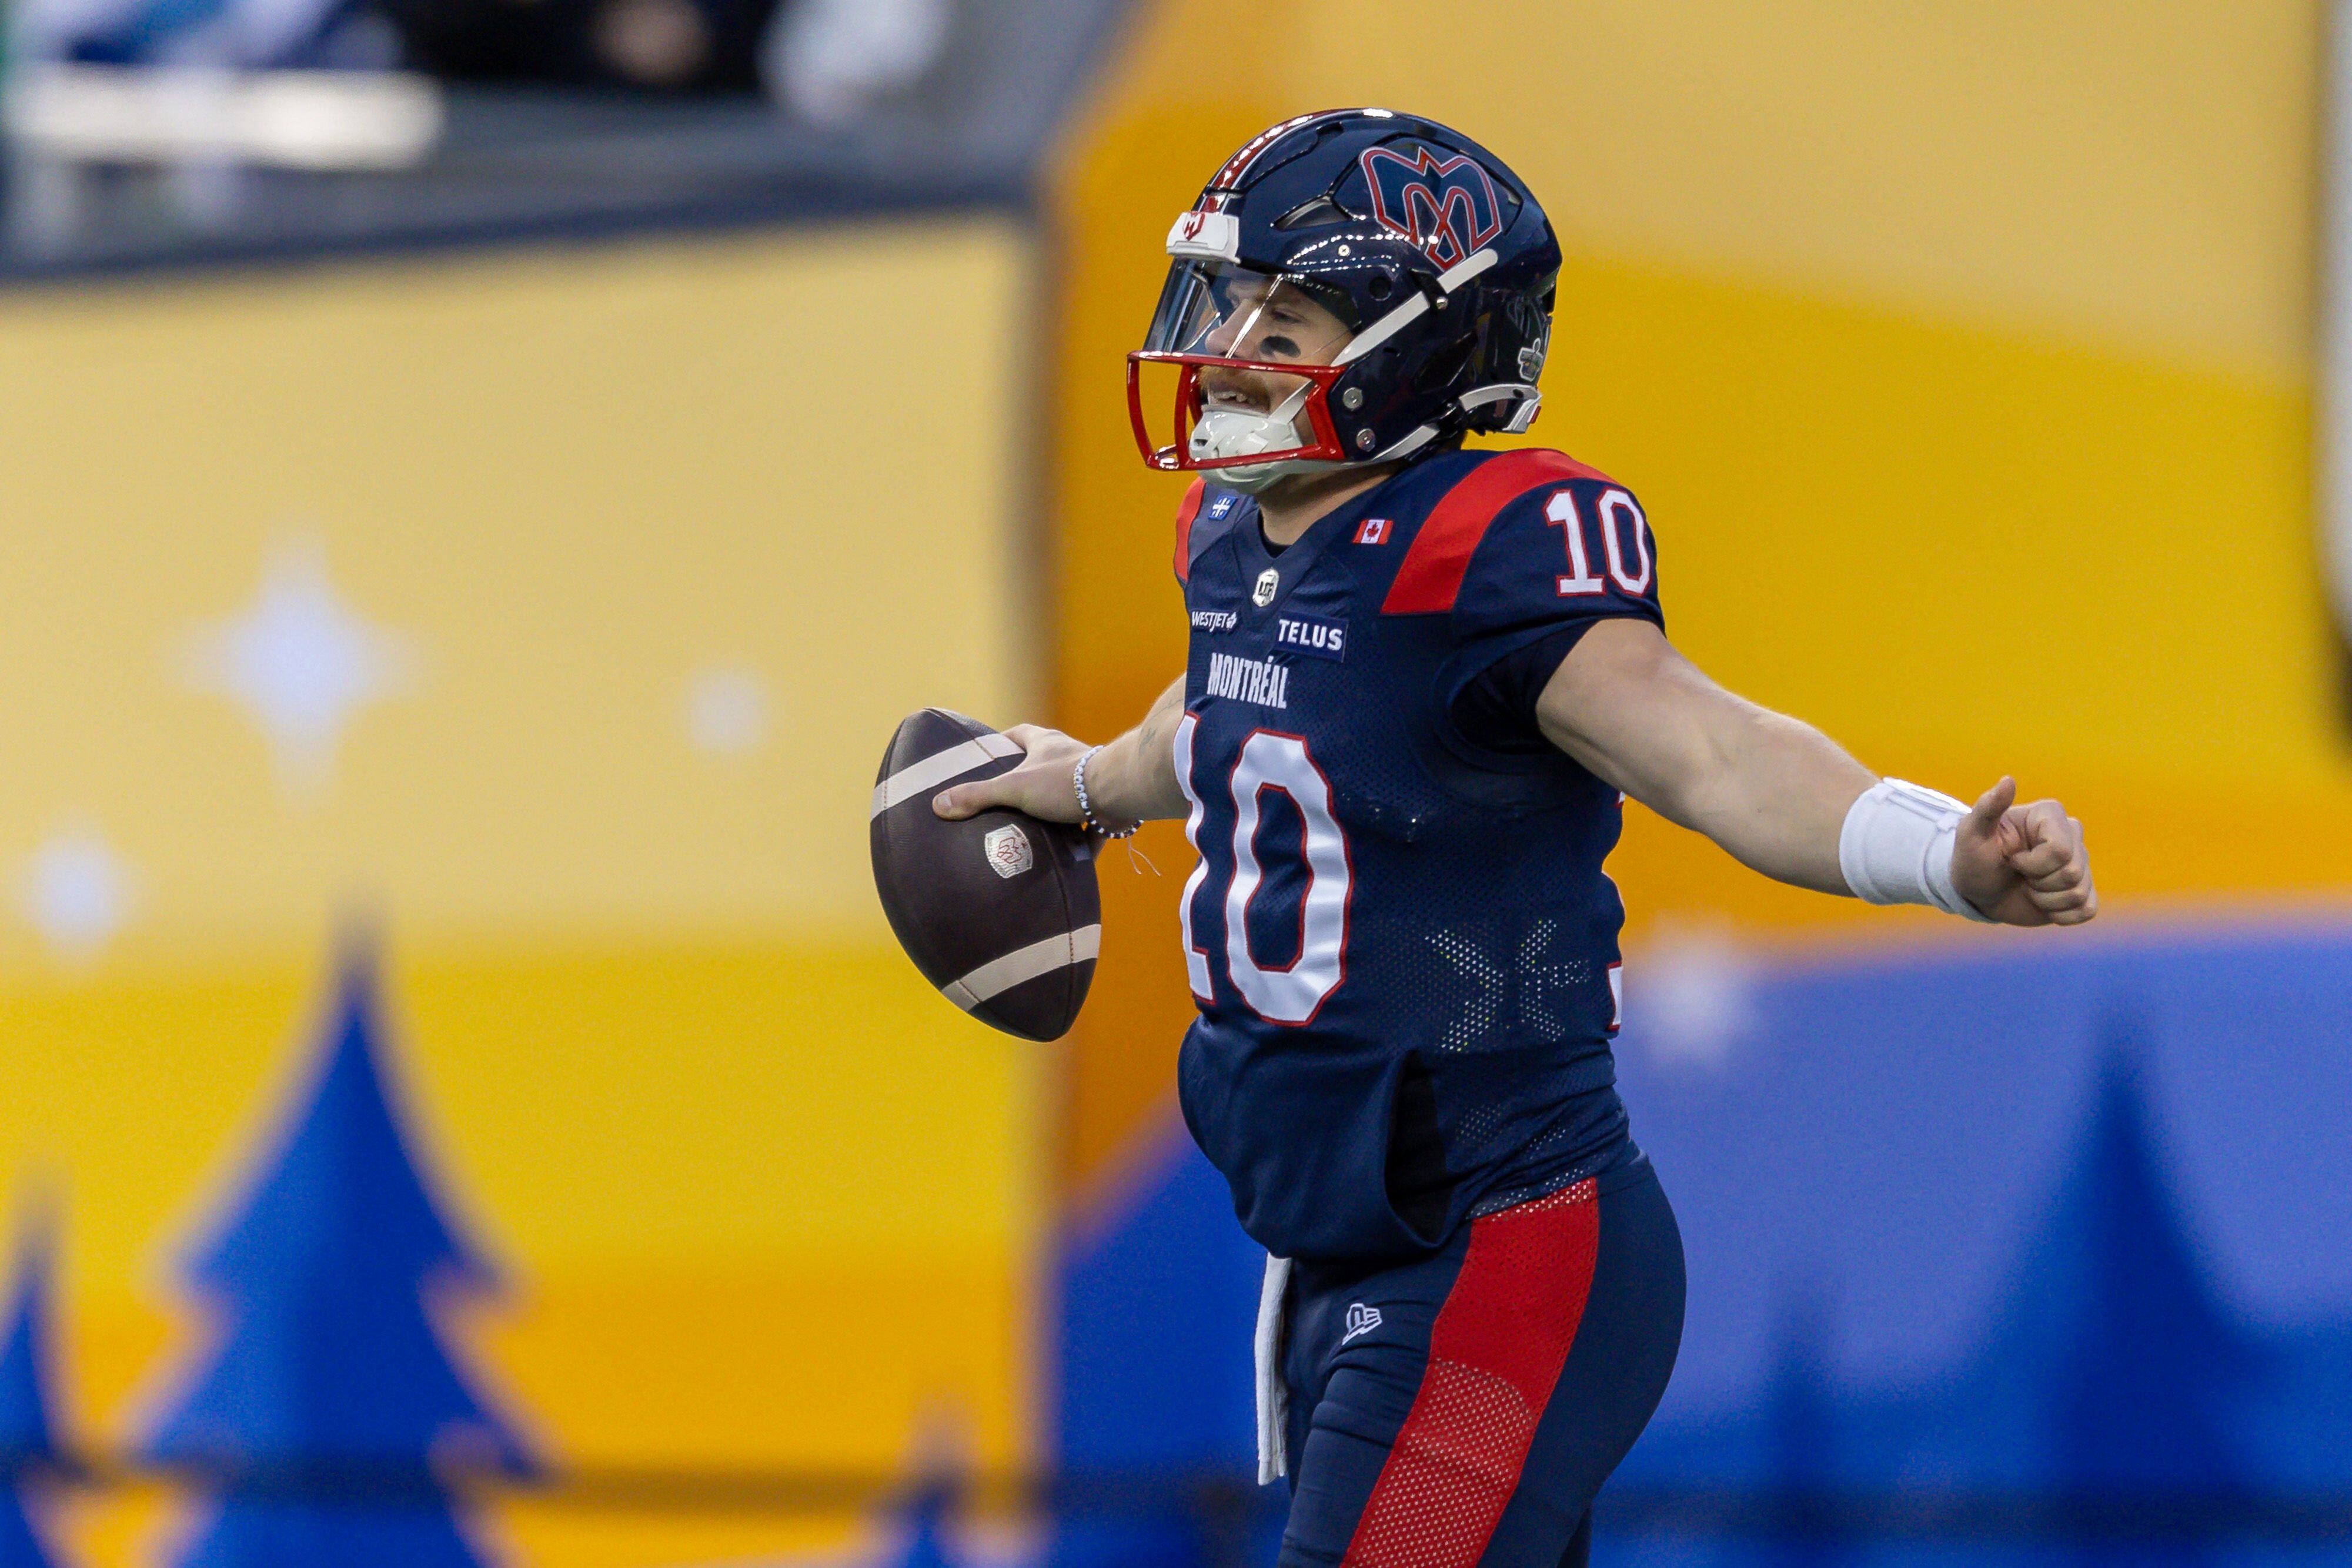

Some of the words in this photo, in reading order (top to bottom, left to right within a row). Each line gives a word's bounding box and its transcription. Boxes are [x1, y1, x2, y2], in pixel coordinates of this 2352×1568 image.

[1542, 487, 1652, 598] 10
[1191, 611, 1230, 633] WESTJET
[1278, 618, 1342, 651] TELUS
[1206, 651, 1289, 710] MONTRÉAL
